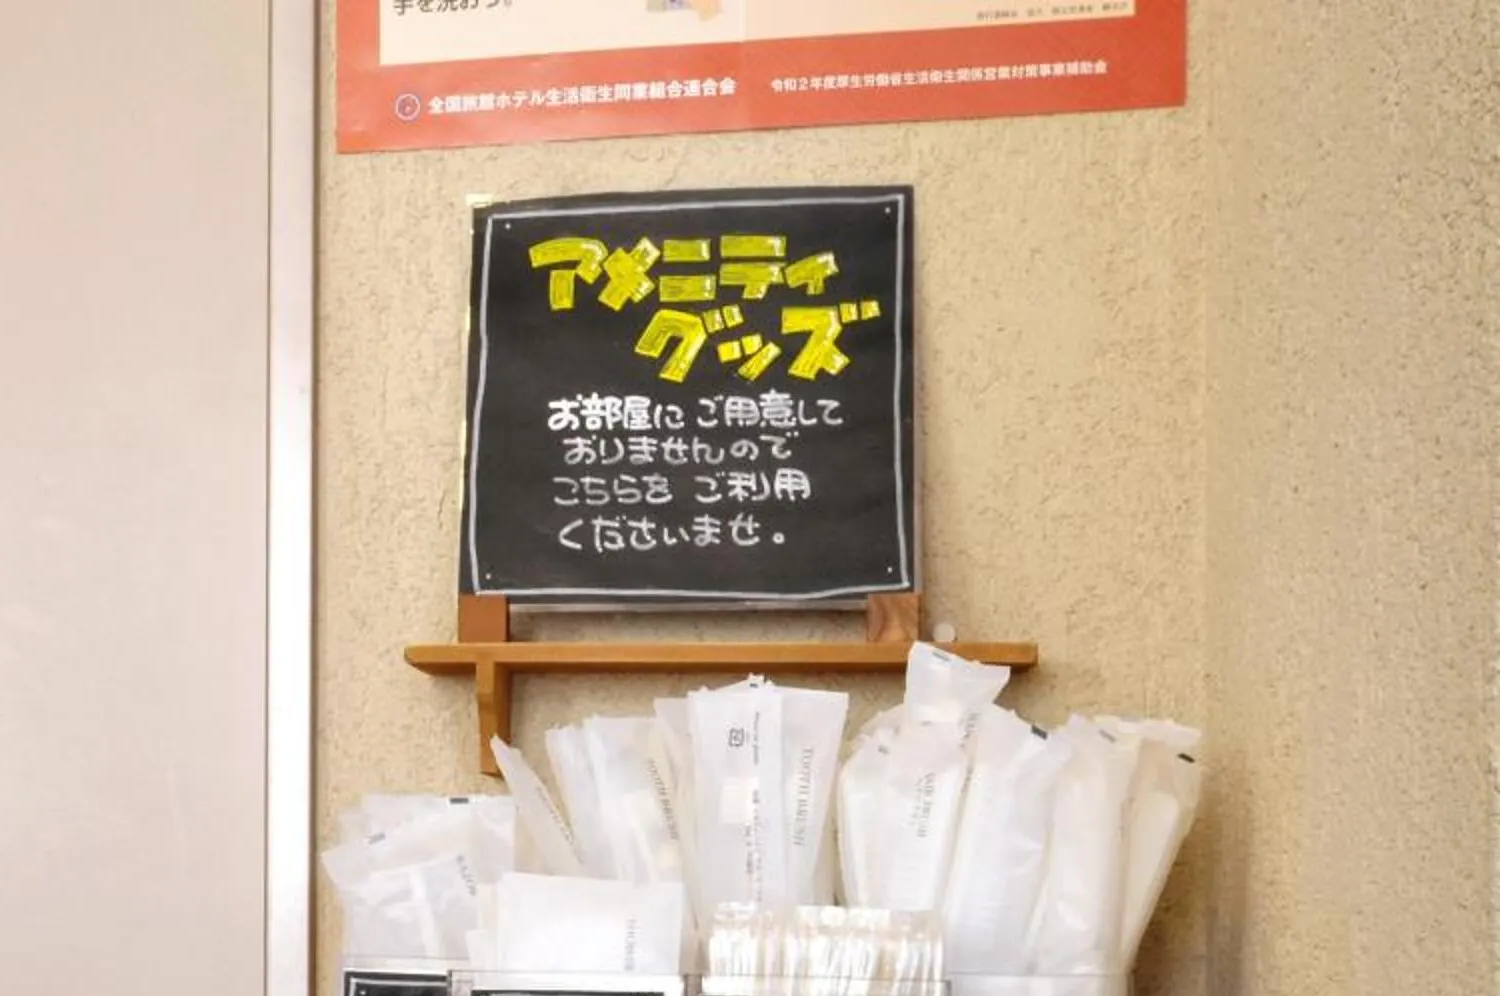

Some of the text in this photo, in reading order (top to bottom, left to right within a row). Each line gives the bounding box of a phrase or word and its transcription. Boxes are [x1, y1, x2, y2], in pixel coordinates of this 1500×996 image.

[428, 77, 737, 115] 全国旅館ホテル生活衛生同業組合連合会
[528, 235, 839, 312] アメニティ
[634, 300, 881, 383] グッズ
[563, 431, 799, 465] おりませんので
[558, 513, 786, 552] くださいませ。
